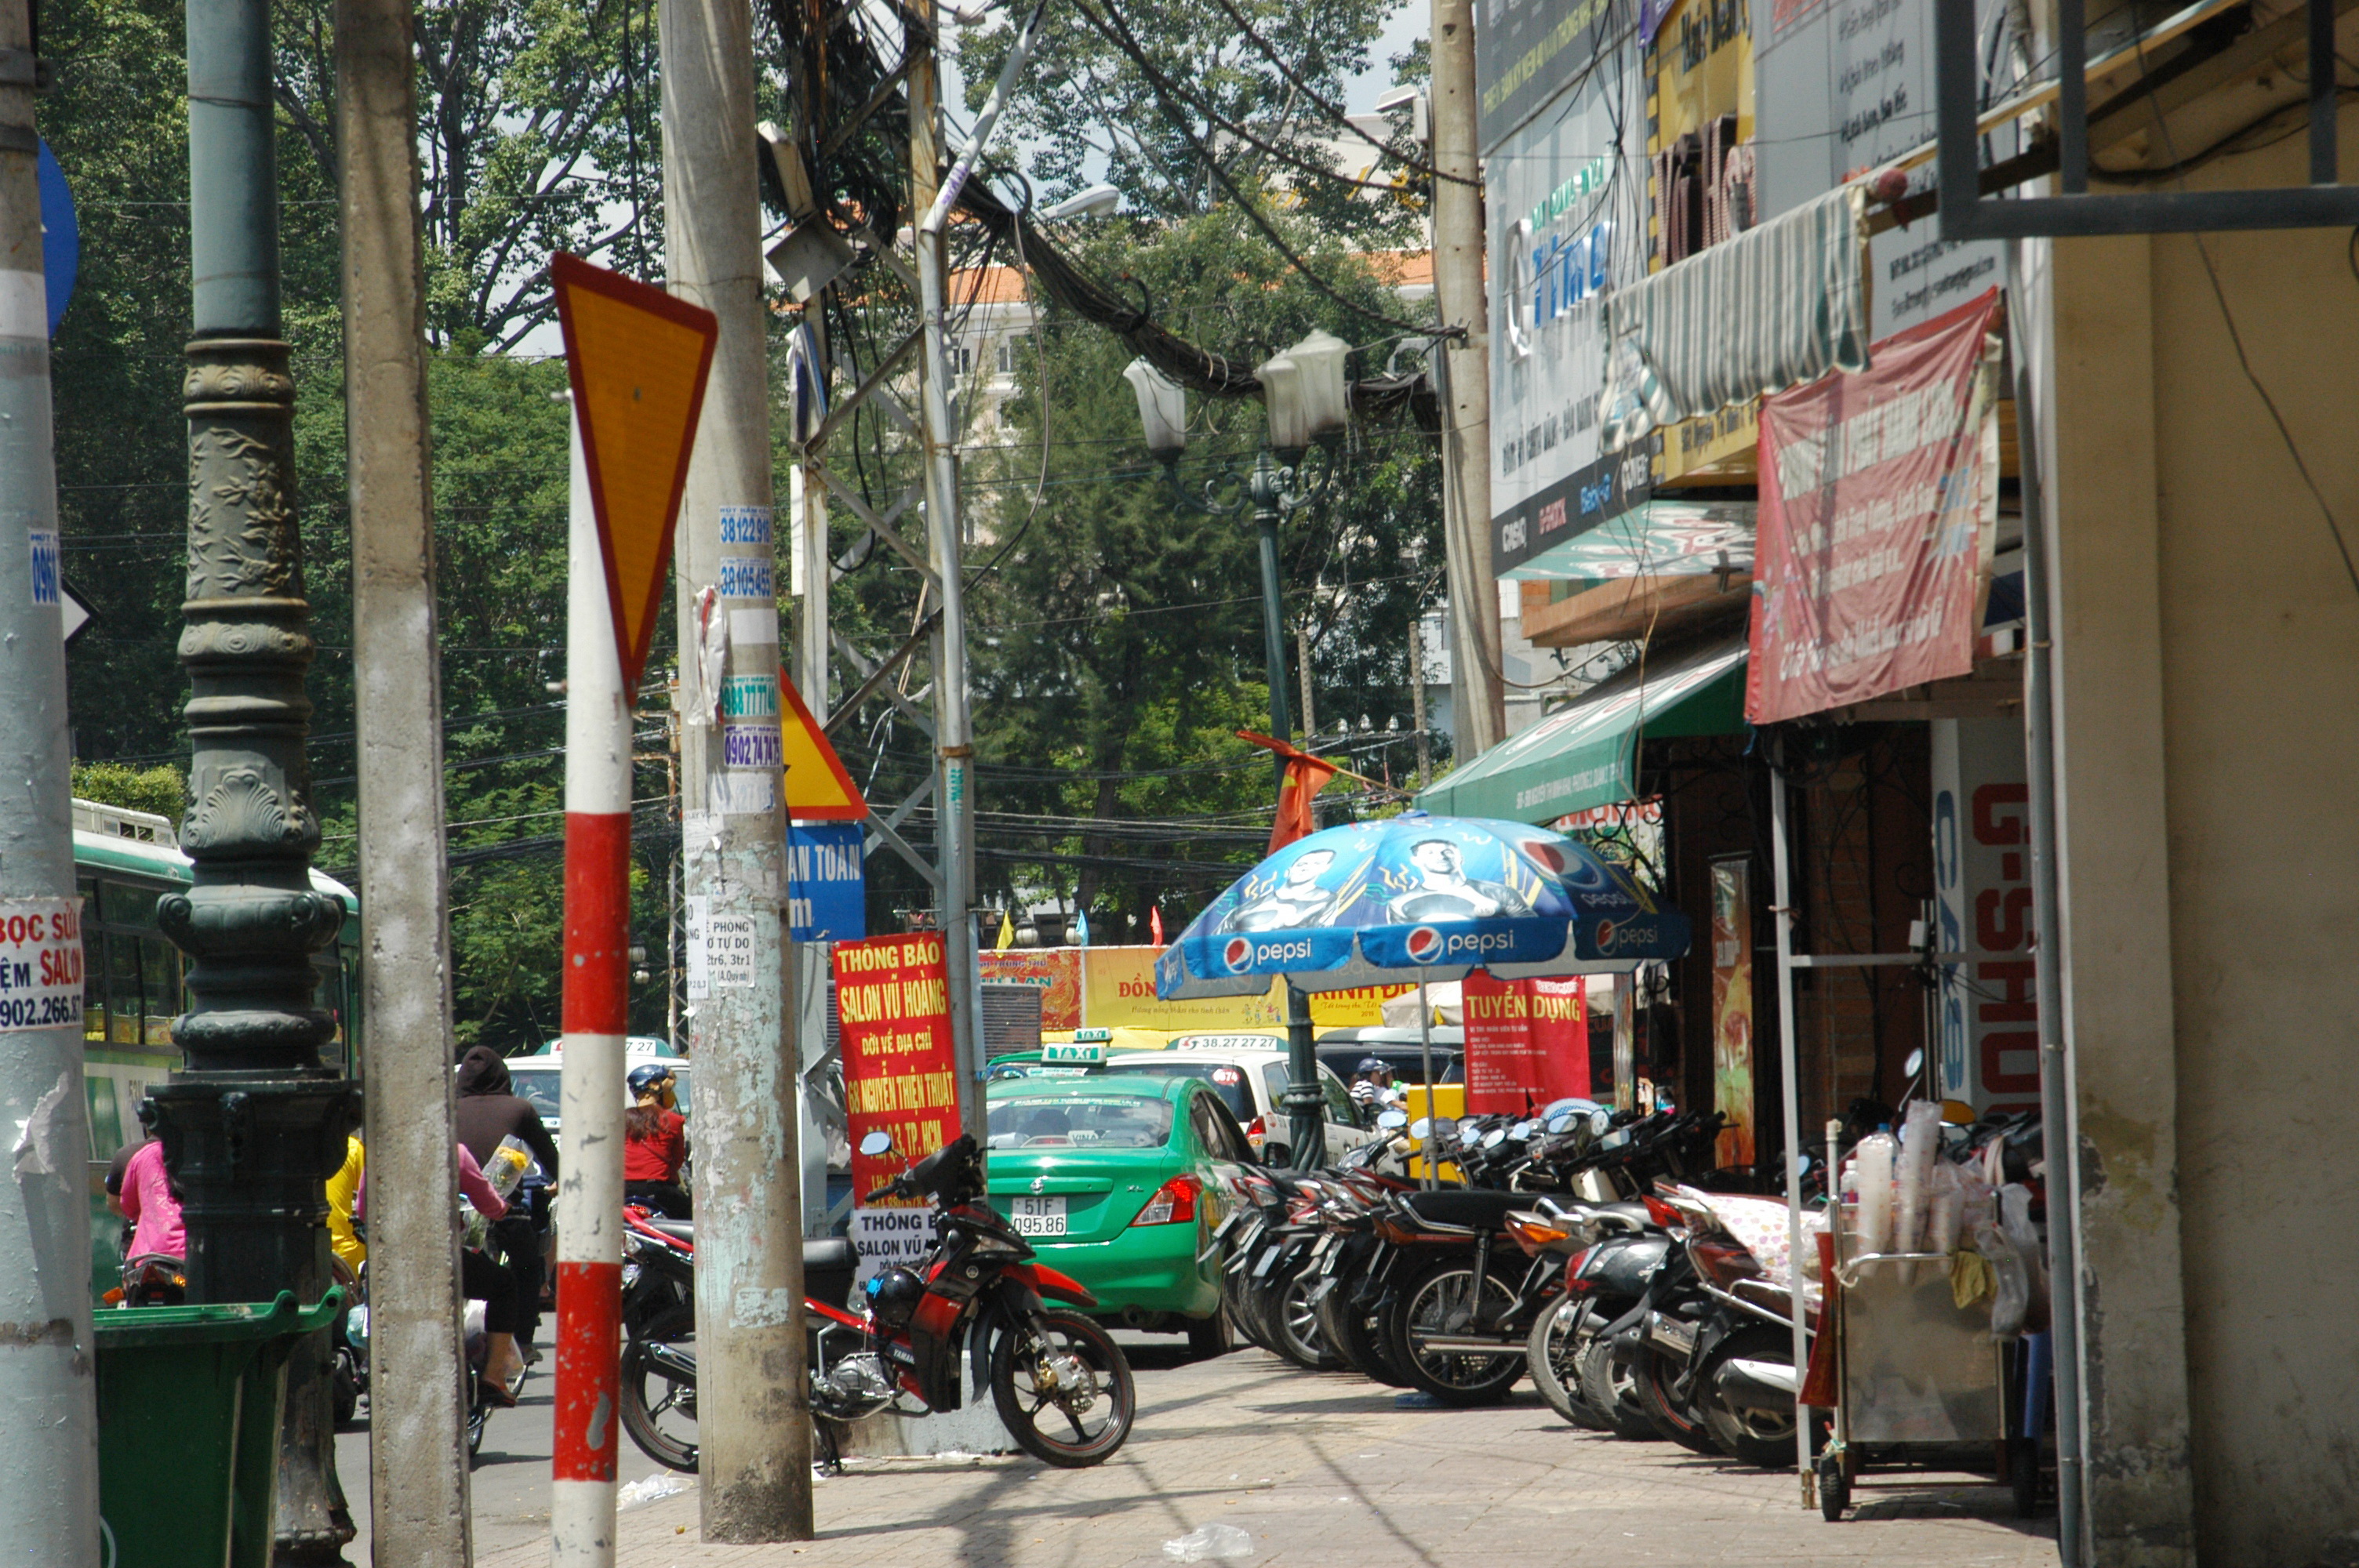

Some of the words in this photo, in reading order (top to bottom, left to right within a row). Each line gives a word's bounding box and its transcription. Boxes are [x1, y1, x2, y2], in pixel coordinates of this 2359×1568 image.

[787, 844, 810, 882] AN
[815, 835, 860, 881] TOÀN
[713, 920, 749, 933] PHÒNG
[1618, 924, 1659, 946] pepsi
[735, 938, 750, 949] DO
[837, 942, 900, 974] THÔNG
[903, 936, 940, 967] BÁO
[1257, 938, 1311, 965] pepsi
[1447, 929, 1514, 956] pepsi
[1971, 782, 2041, 1116] G-SHO
[840, 983, 882, 1024] SALON
[882, 973, 901, 1020] VŨ
[903, 969, 947, 1018] HOÀNG
[1118, 972, 1158, 998] ĐỒN
[1466, 985, 1528, 1019] TUYỂN
[1532, 995, 1581, 1024] DỤNG
[637, 1041, 653, 1051] 27
[861, 1032, 879, 1056] DỜI
[896, 1033, 914, 1056] ĐỊA
[915, 1025, 932, 1050] CHỈ
[1202, 1037, 1238, 1048] 38.27
[1241, 1037, 1257, 1048] 27
[1259, 1037, 1276, 1048] 27
[848, 1080, 860, 1115] 68
[860, 1060, 897, 1113] NGUYỄN
[896, 1065, 925, 1116] THIỆN
[925, 1063, 954, 1114] THUẬT
[921, 1120, 943, 1156] HCM
[1024, 1198, 1053, 1215] 51F
[860, 1211, 922, 1232] THÔNG
[857, 1240, 900, 1257] SALON
[903, 1234, 921, 1255] VŨ
